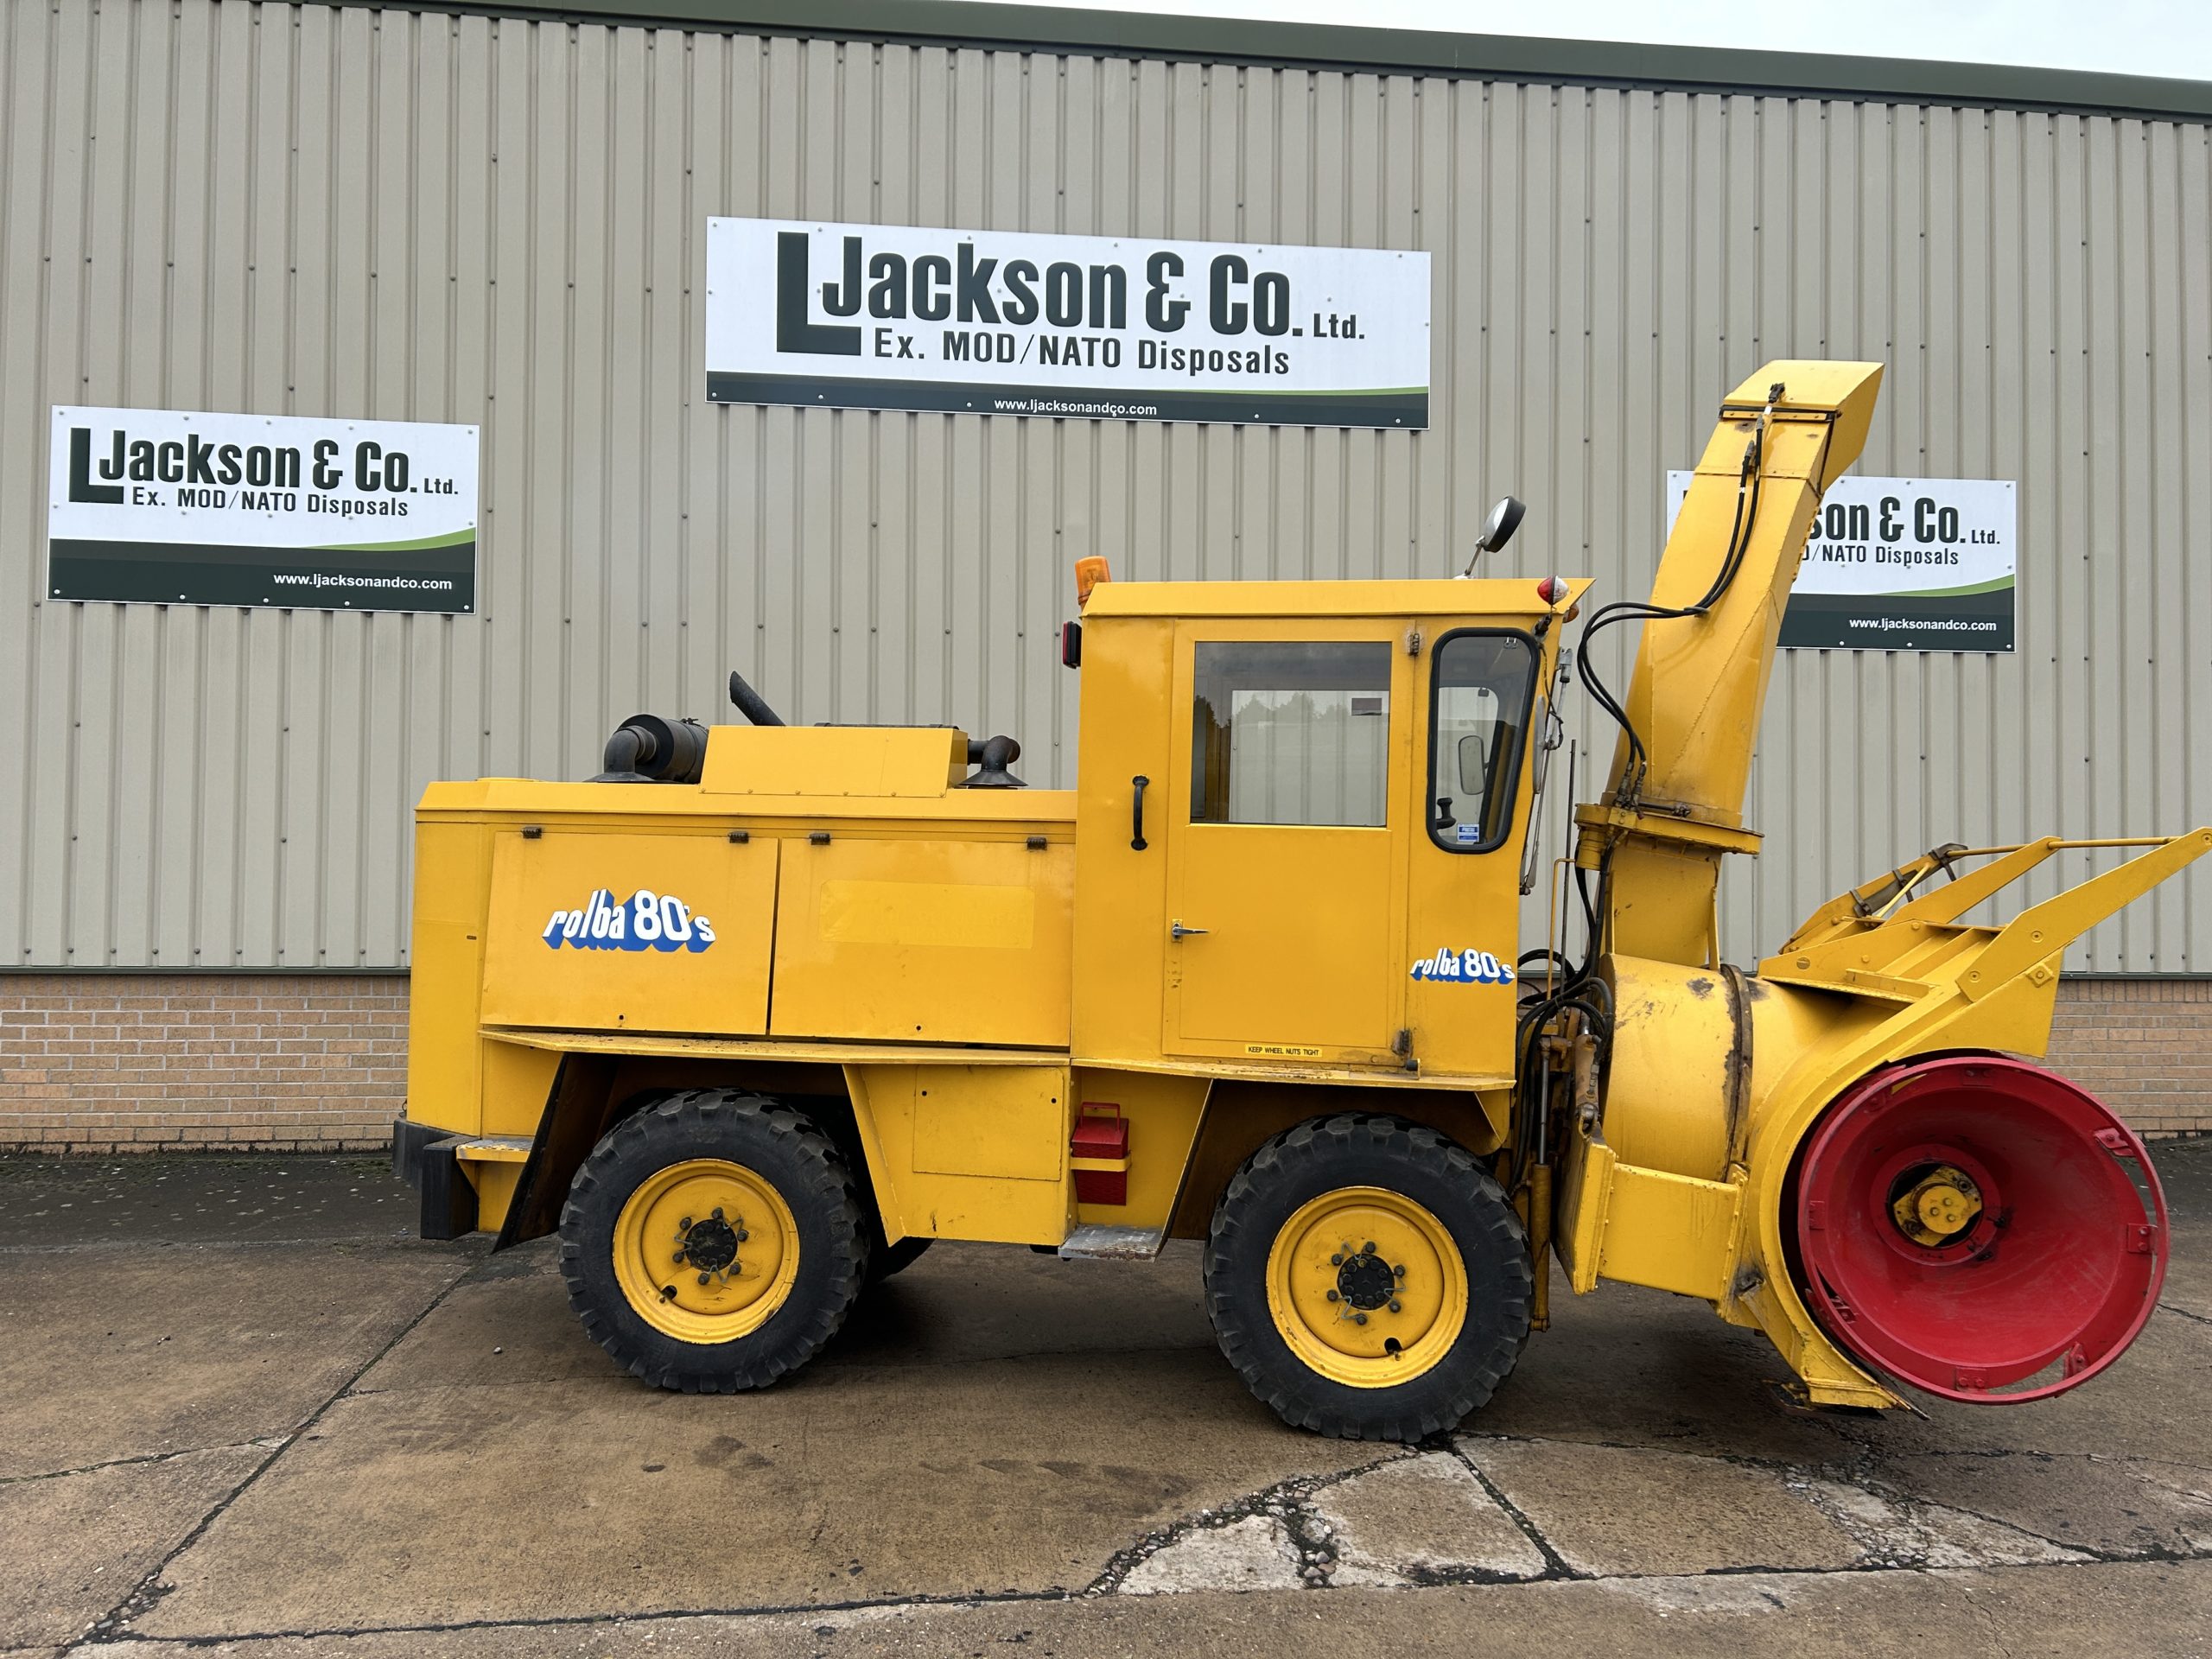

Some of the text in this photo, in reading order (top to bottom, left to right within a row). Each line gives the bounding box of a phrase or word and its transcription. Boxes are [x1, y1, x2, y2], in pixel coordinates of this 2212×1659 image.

[1146, 251, 1192, 333] &
[1209, 254, 1303, 337] Co.
[1313, 313, 1365, 340] Ltd.
[874, 327, 1289, 377] Ex. MOD/NATO Disposals
[994, 398, 1158, 416] www.ljacksonandco.com
[312, 439, 344, 491] &
[355, 441, 418, 493] Co.
[423, 478, 459, 494] Ltd.
[132, 486, 408, 518] Ex. MOD/NATO Disposals
[1879, 496, 1904, 543] &
[1914, 497, 1967, 543] Co.
[1971, 529, 2000, 545] Ltd.
[1875, 546, 1959, 567] Disposals
[273, 573, 452, 590] www.ljacksonandco.com
[1849, 618, 1997, 632] www.ljacksonandco.com
[542, 889, 716, 953] rolba 80's
[1410, 948, 1461, 981] rolba
